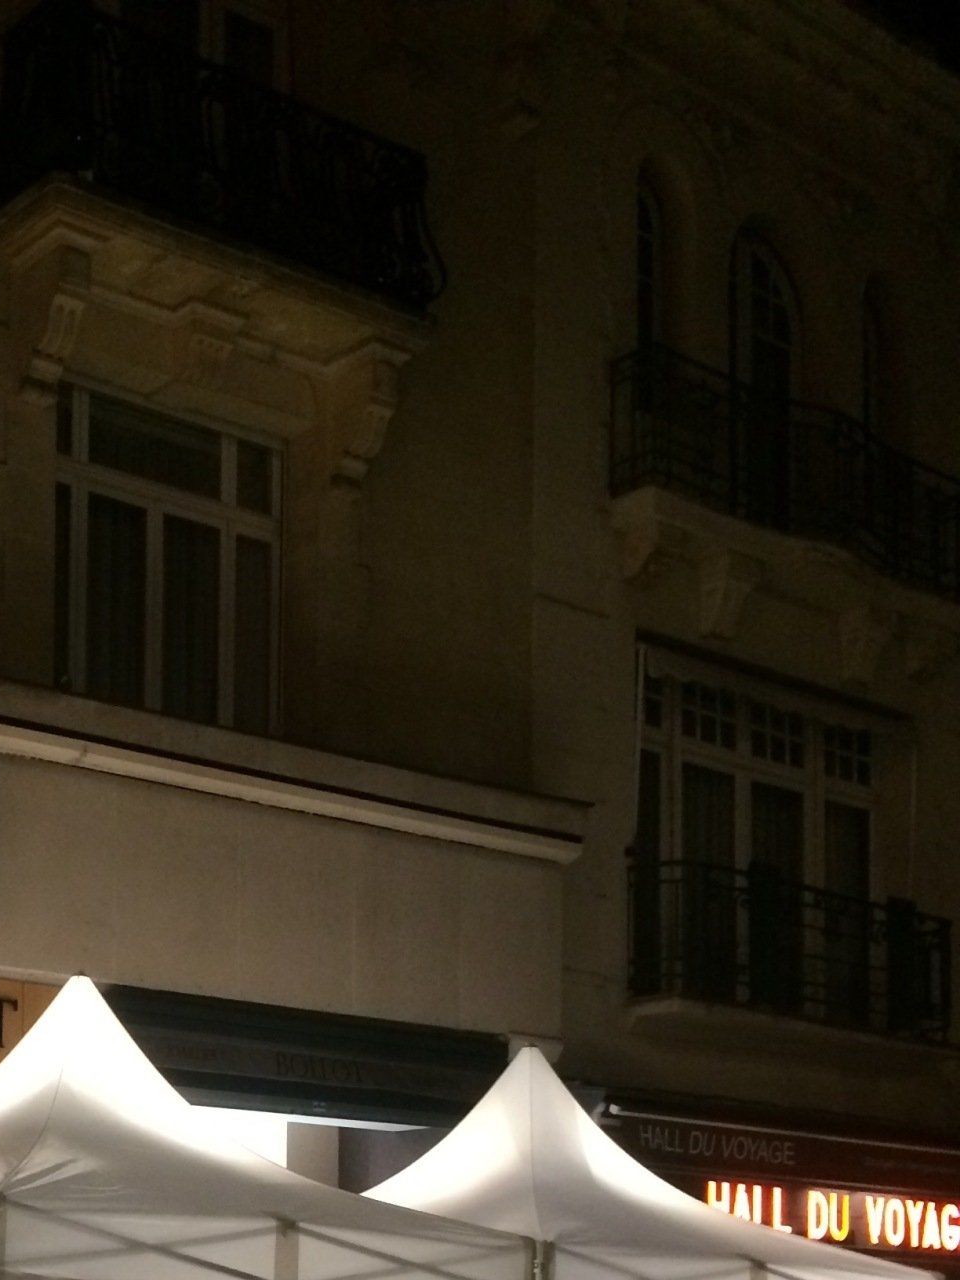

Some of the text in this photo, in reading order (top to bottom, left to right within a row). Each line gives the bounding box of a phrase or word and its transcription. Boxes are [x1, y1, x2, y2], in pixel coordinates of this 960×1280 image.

[640, 1124, 796, 1165] HALL DU VOYAGE
[707, 1180, 960, 1251] HALL DU VOYAG
